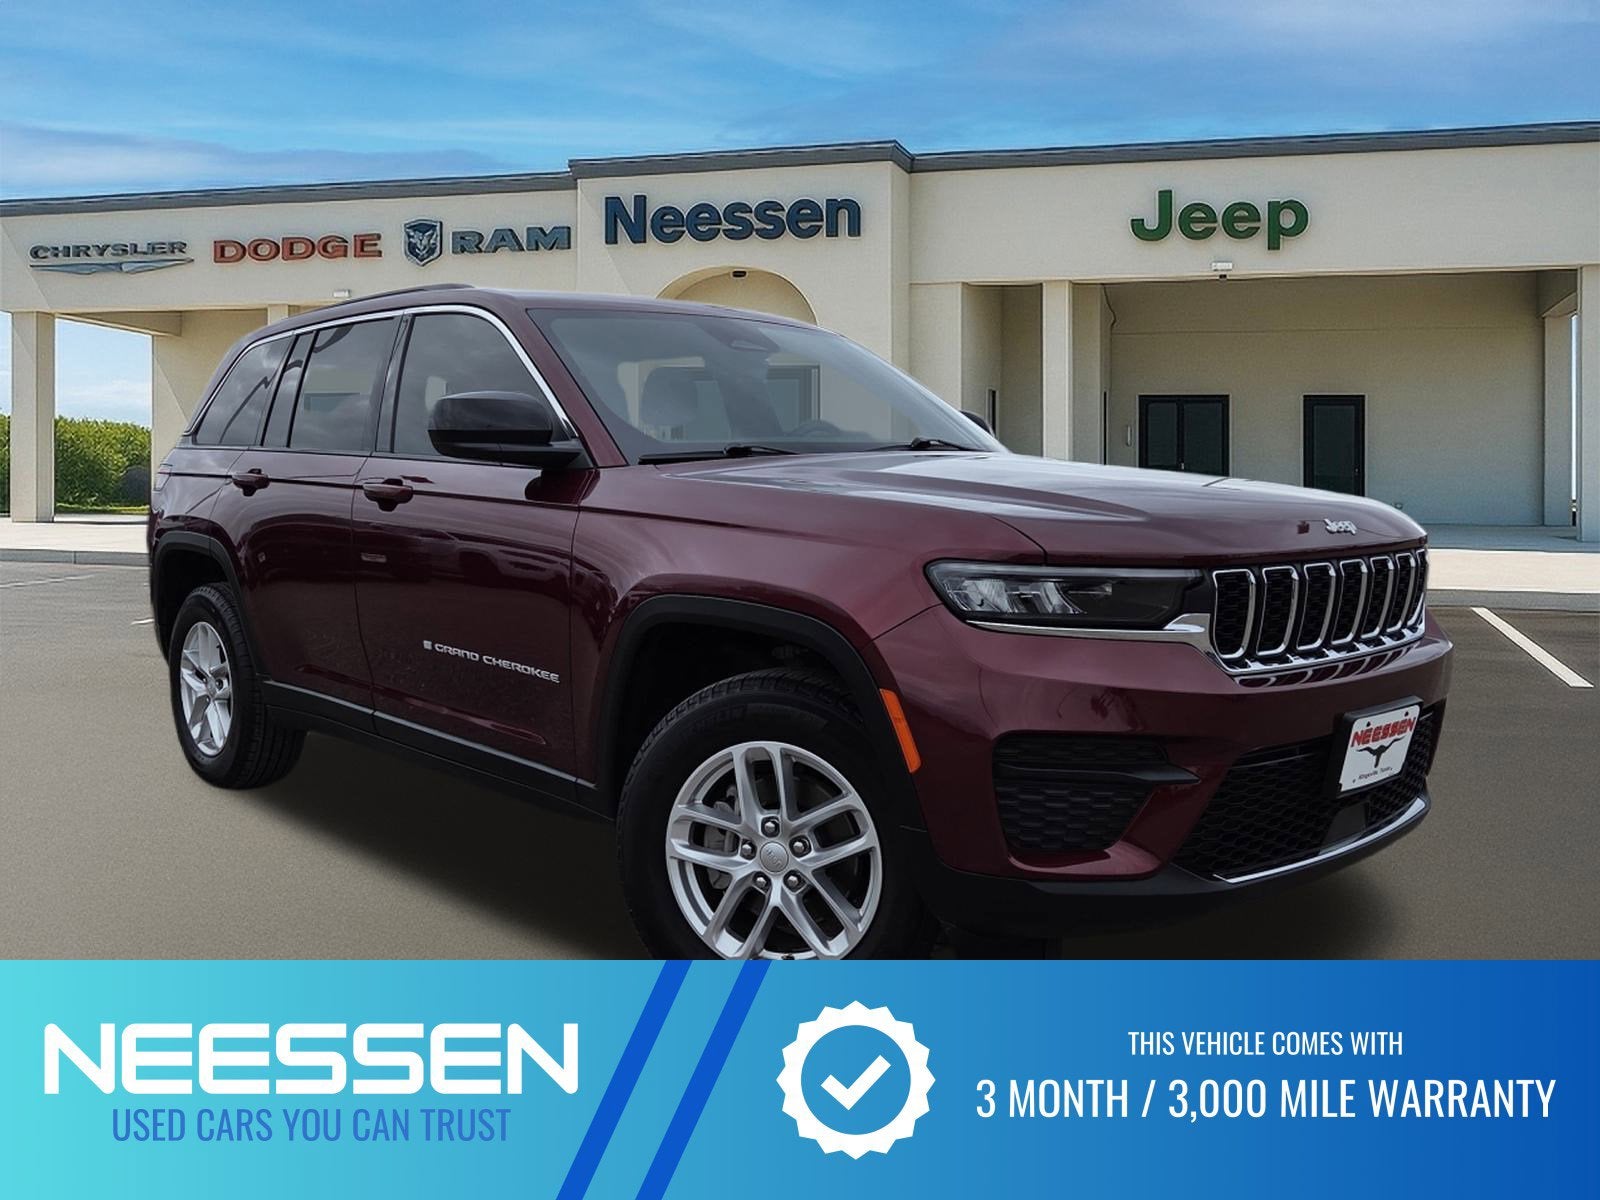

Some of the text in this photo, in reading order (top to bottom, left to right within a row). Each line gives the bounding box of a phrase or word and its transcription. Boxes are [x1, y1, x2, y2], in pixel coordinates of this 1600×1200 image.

[604, 195, 862, 245] Neessen
[1130, 189, 1309, 250] Jeep
[29, 240, 188, 260] CHRYSLER
[213, 233, 382, 264] DODGE
[451, 226, 571, 255] RAM
[1324, 518, 1357, 536] Jeep
[434, 643, 560, 683] GRAND CHEROKEE
[1351, 717, 1416, 747] NEESSEN
